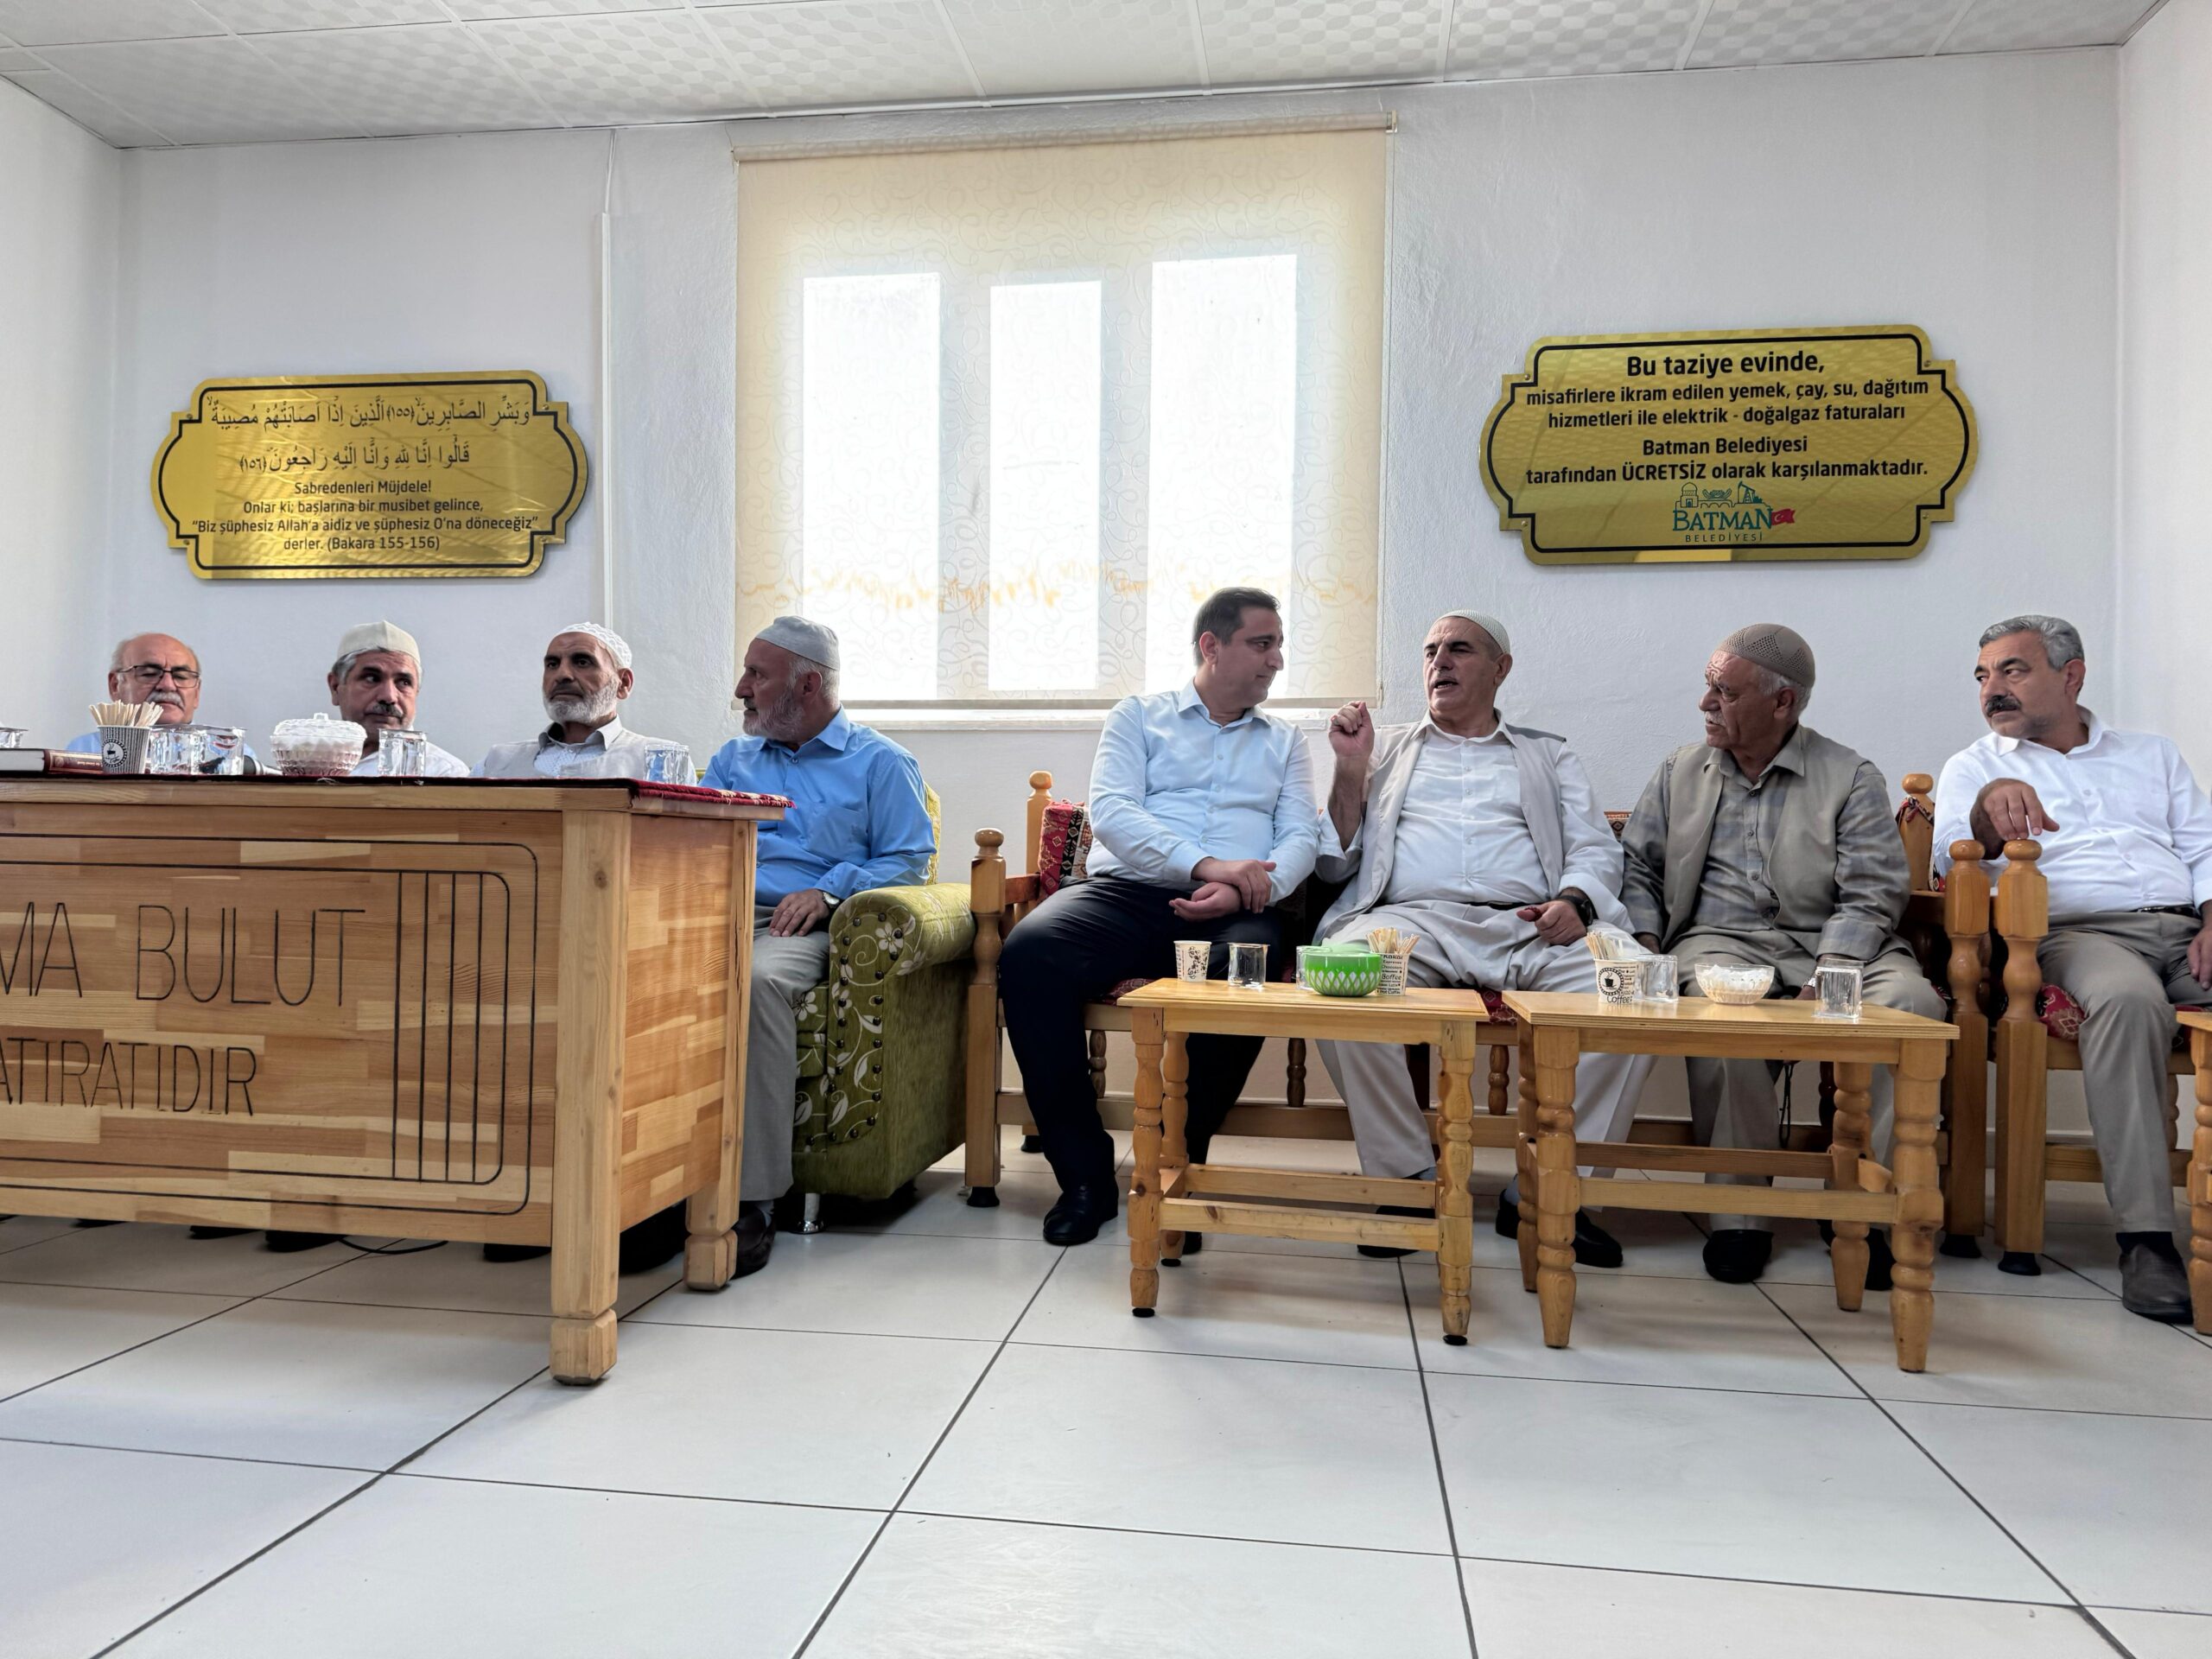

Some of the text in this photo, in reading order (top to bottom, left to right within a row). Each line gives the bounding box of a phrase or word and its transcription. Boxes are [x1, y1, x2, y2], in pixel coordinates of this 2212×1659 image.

[1627, 351, 1825, 379] Bu taziye evinde,
[1526, 378, 1929, 405] misafirlere ikram edilen yemek, çay, su, dağıtım
[1548, 410, 1632, 429] hizmetleri
[1637, 410, 1658, 425] ile
[1662, 407, 1728, 425] elektrik
[1743, 406, 1820, 426] doğalgaz
[1824, 404, 1905, 422] faturaları
[1643, 435, 1808, 457] Batman Belediyesi
[1525, 459, 1928, 485] tarafından ÜCRETSİZ olarak karşılanmaktadır.
[295, 480, 431, 495] Sabredenleri Müjdele!
[244, 499, 483, 516] Onlar ki; başlarına bir musibet gelince,
[219, 519, 273, 535] şüphesiz
[322, 518, 351, 531] aidiz
[355, 522, 370, 531] ve
[374, 518, 429, 533] şüphesiz
[434, 518, 461, 530] O'na
[1672, 508, 1773, 531] BATMAN
[284, 537, 440, 552] derler. (Bakara 155-156)
[1685, 531, 1763, 543] BELEDİYESİ
[136, 904, 365, 1007] BULUT
